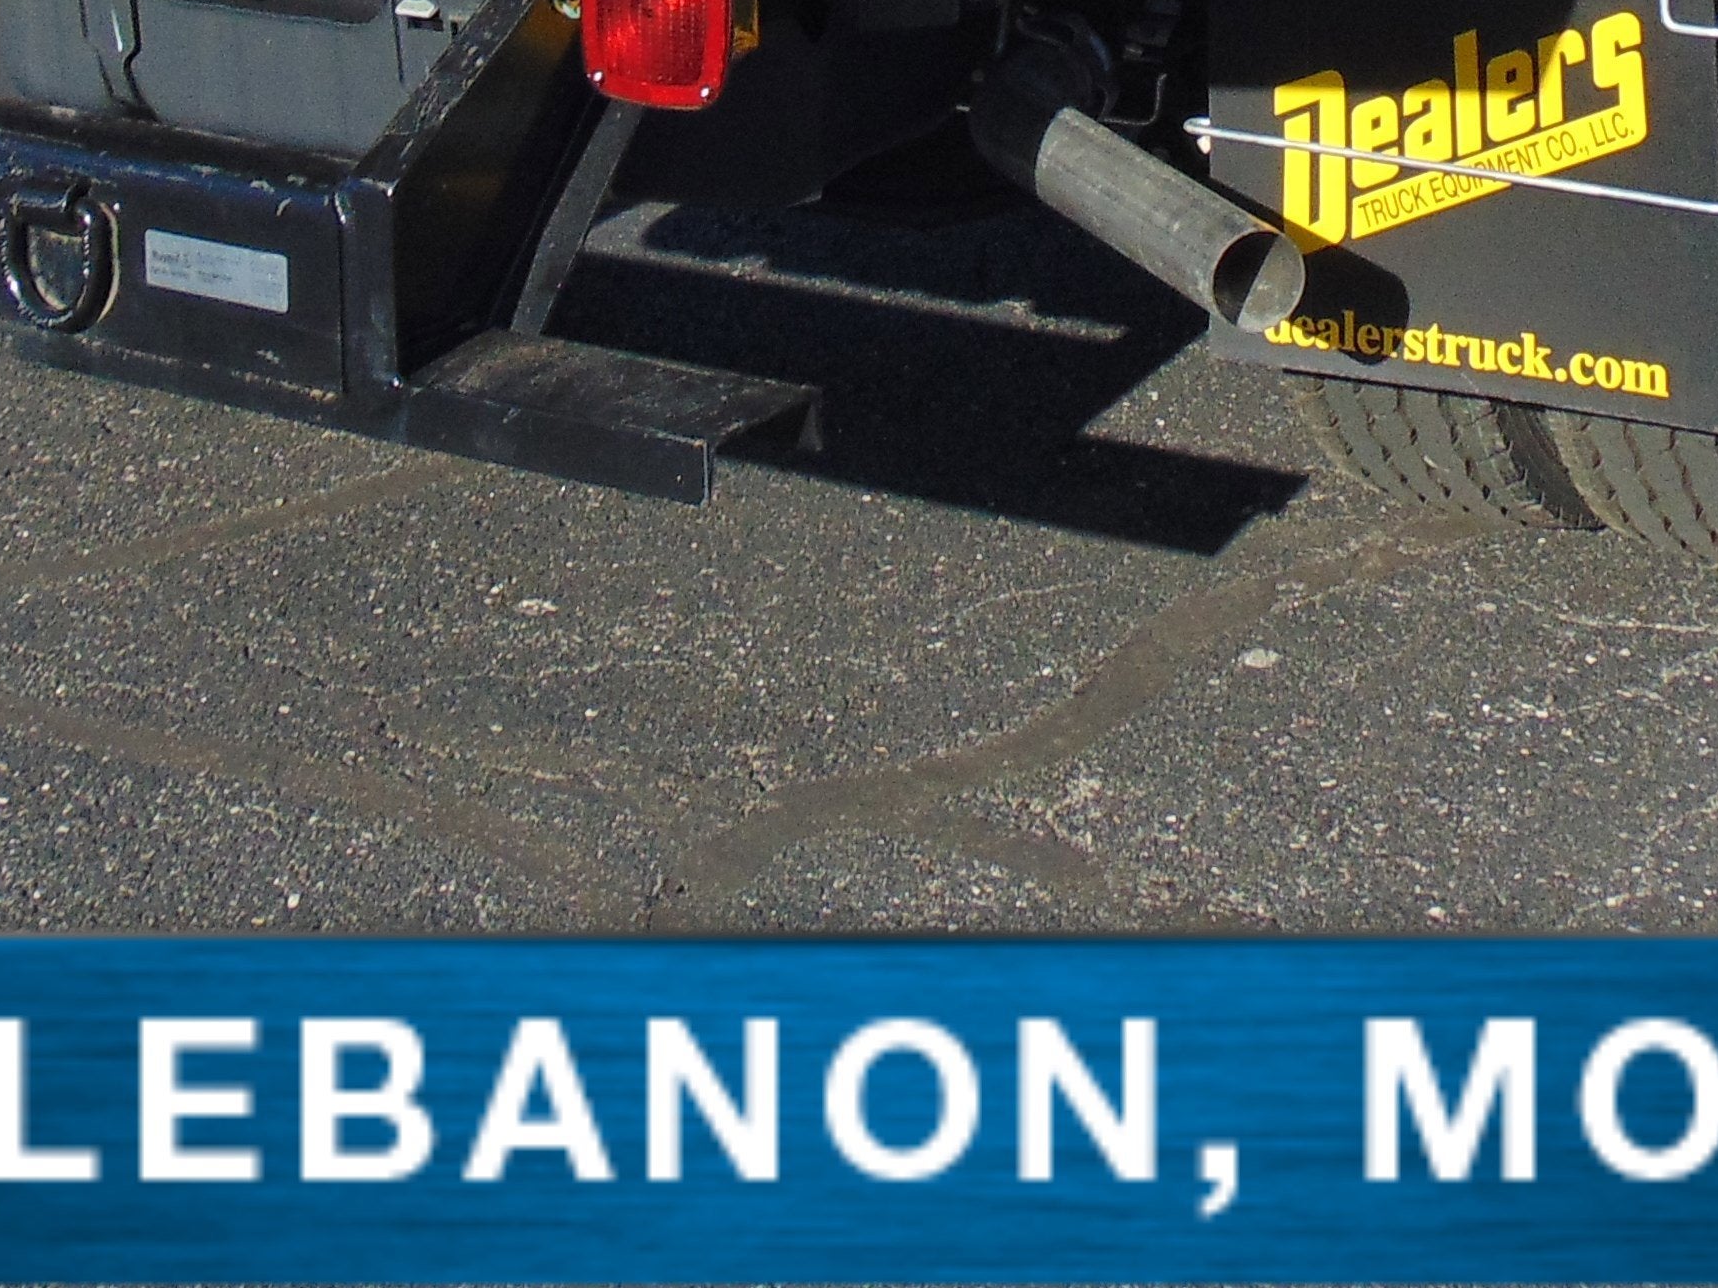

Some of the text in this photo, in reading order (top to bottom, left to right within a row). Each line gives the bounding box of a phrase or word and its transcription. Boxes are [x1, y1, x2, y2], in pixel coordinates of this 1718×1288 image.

[1272, 11, 1648, 256] Dealers
[1358, 185, 1427, 230] TRUCK
[1591, 110, 1636, 150] LLC.
